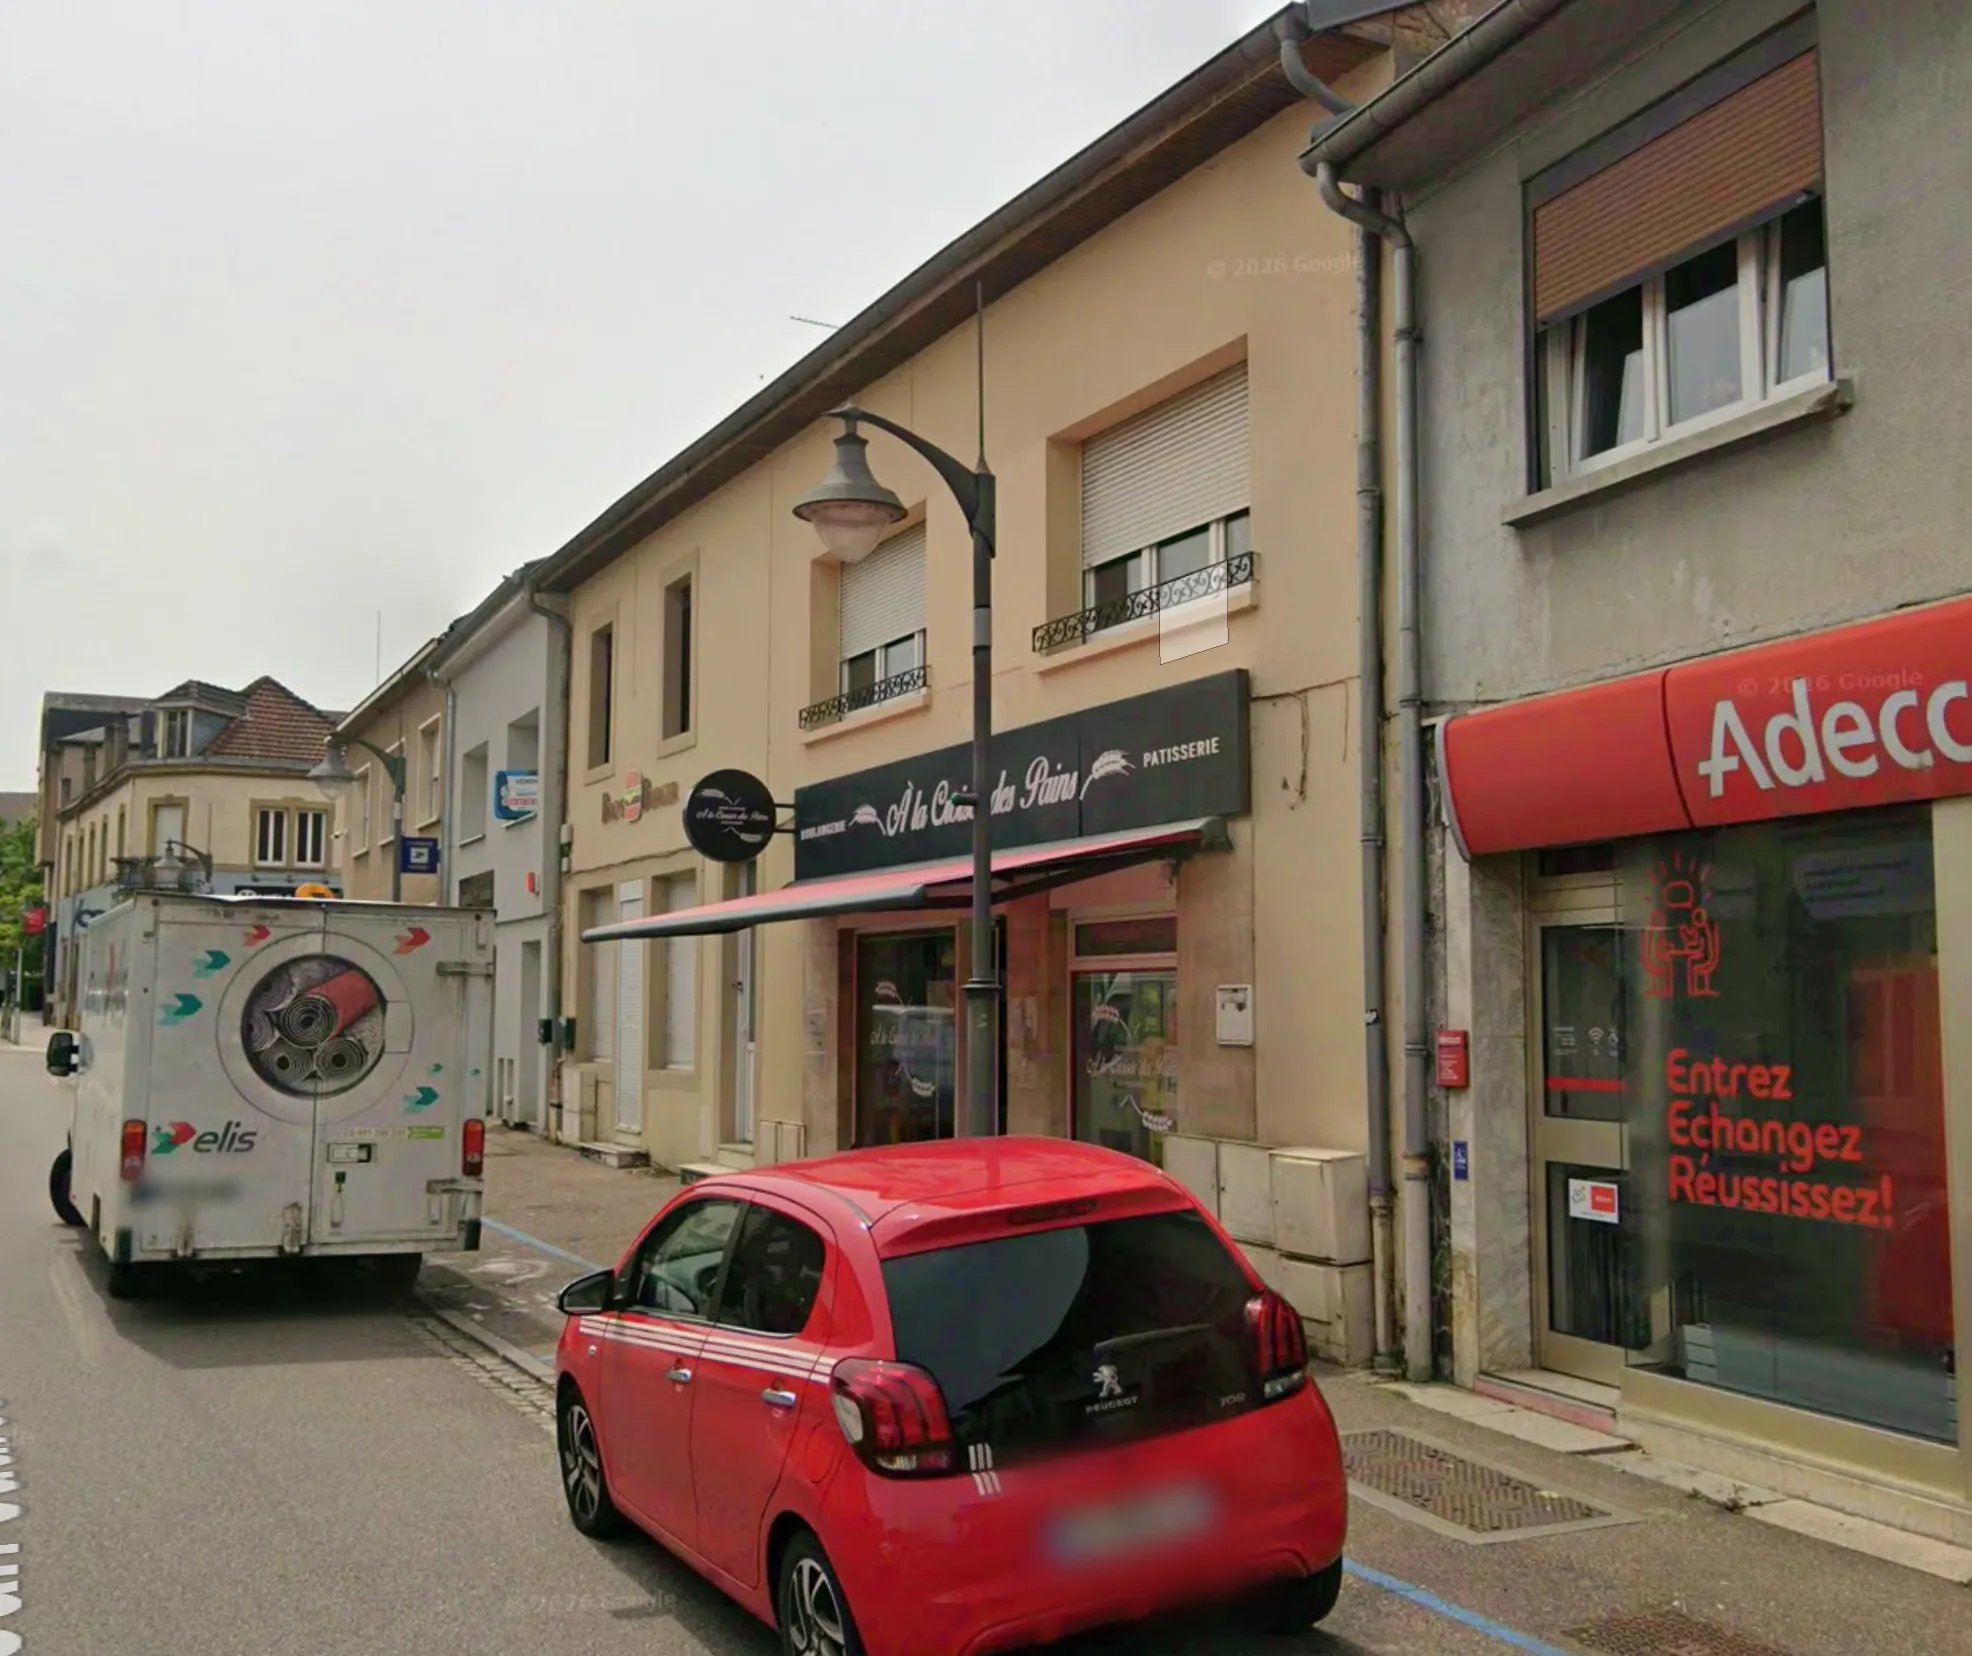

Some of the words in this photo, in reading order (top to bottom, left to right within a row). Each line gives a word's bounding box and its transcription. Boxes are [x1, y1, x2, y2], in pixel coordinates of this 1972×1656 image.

[1143, 736, 1220, 768] PATISSERIE
[1697, 677, 1972, 798] Adecc
[910, 790, 928, 831] la
[991, 769, 1016, 816] des
[1020, 755, 1079, 810] Pains
[1666, 1048, 1793, 1100] Entrez
[193, 1120, 257, 1153] elis
[1667, 1100, 1864, 1173] Echangez
[1668, 1152, 1895, 1230] Réussissez!
[1085, 1395, 1139, 1413] PEUGEOT
